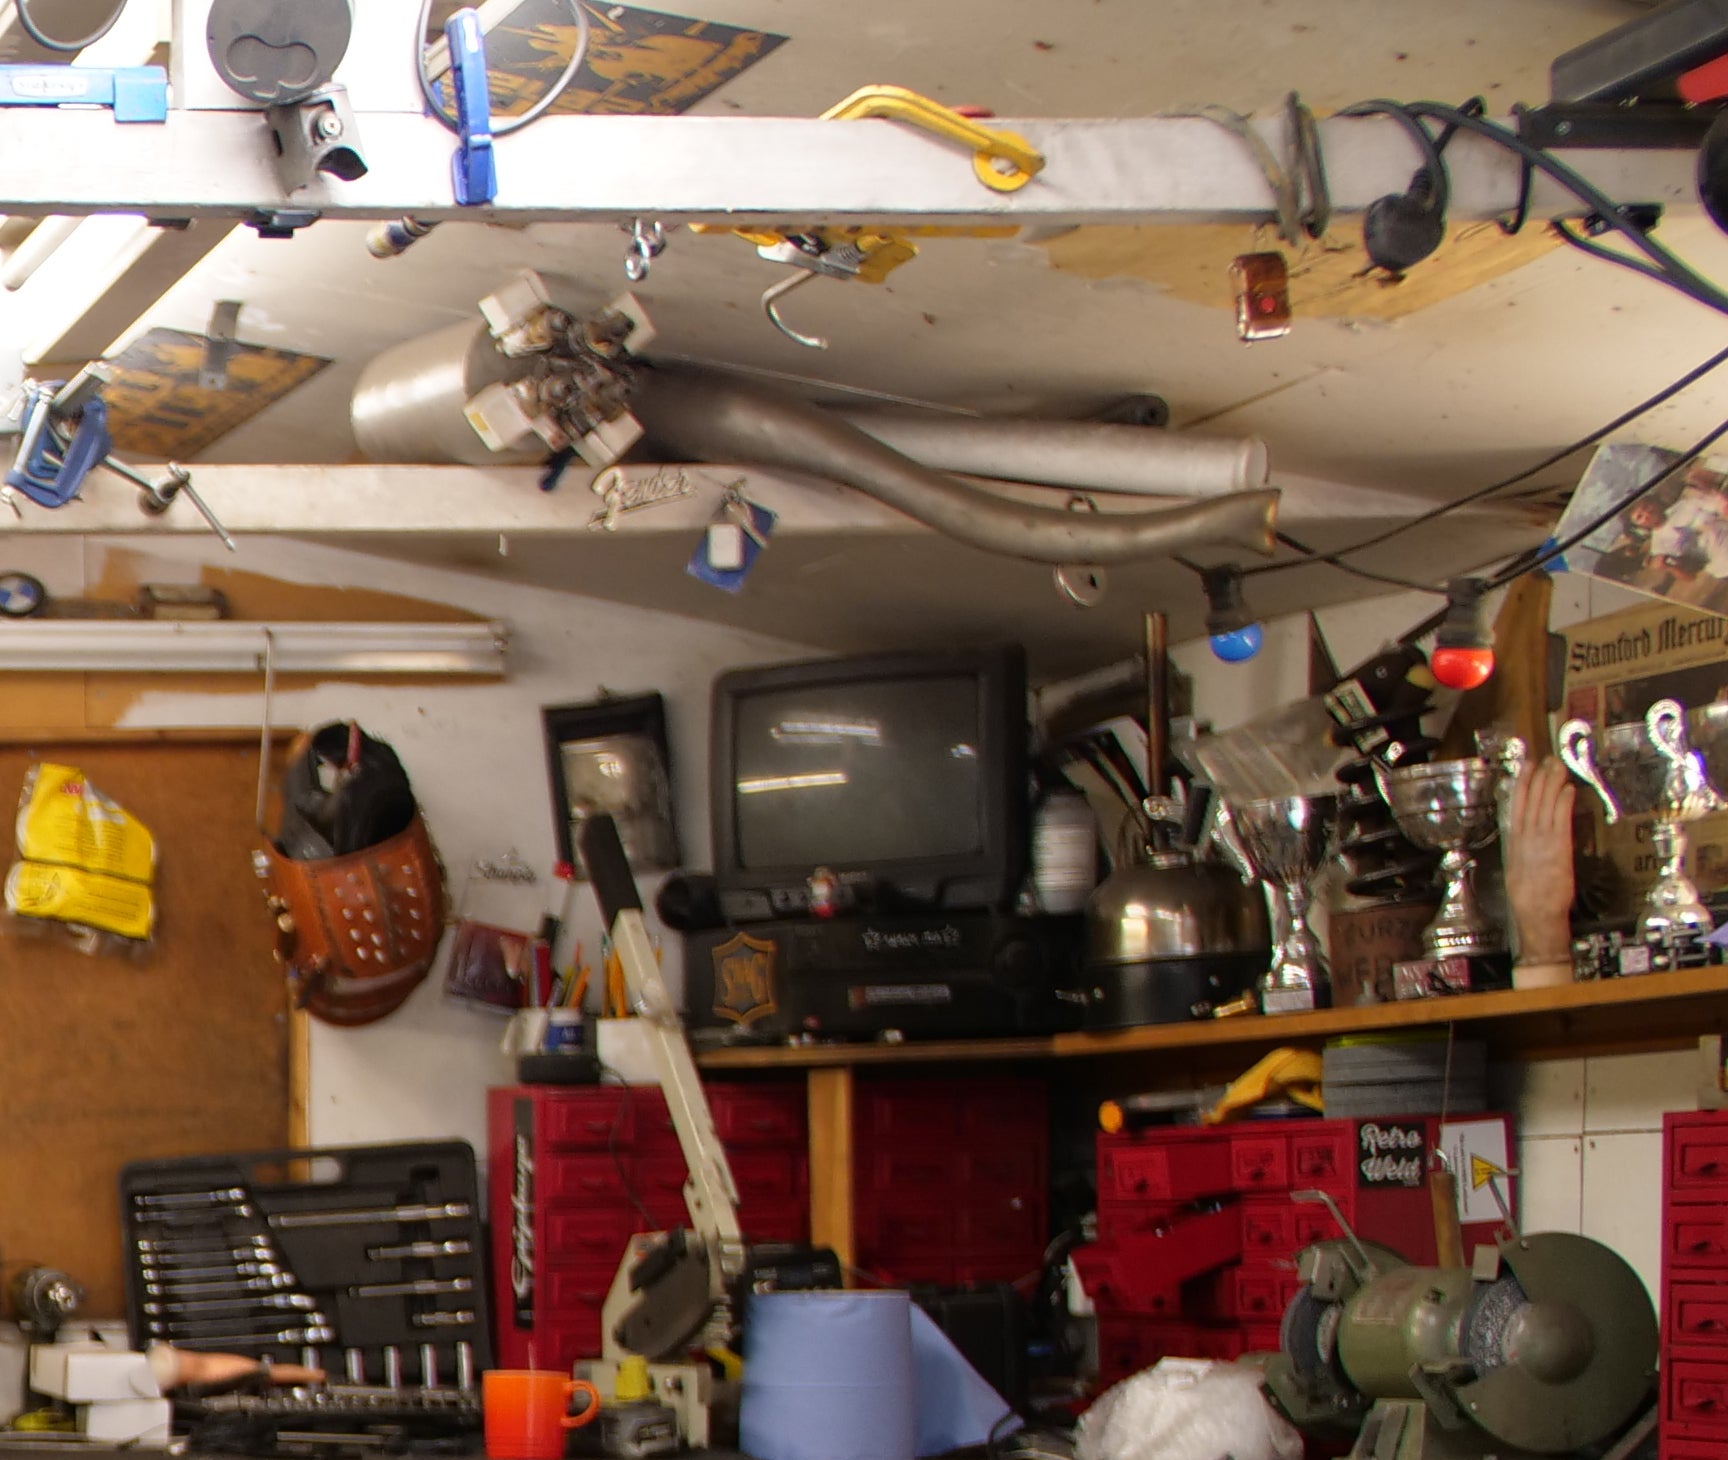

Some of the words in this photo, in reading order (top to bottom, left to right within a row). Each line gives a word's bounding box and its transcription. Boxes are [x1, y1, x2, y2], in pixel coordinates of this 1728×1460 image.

[1568, 629, 1651, 672] Stamford
[1656, 614, 1728, 654] Mercur
[1360, 1123, 1422, 1157] Retro
